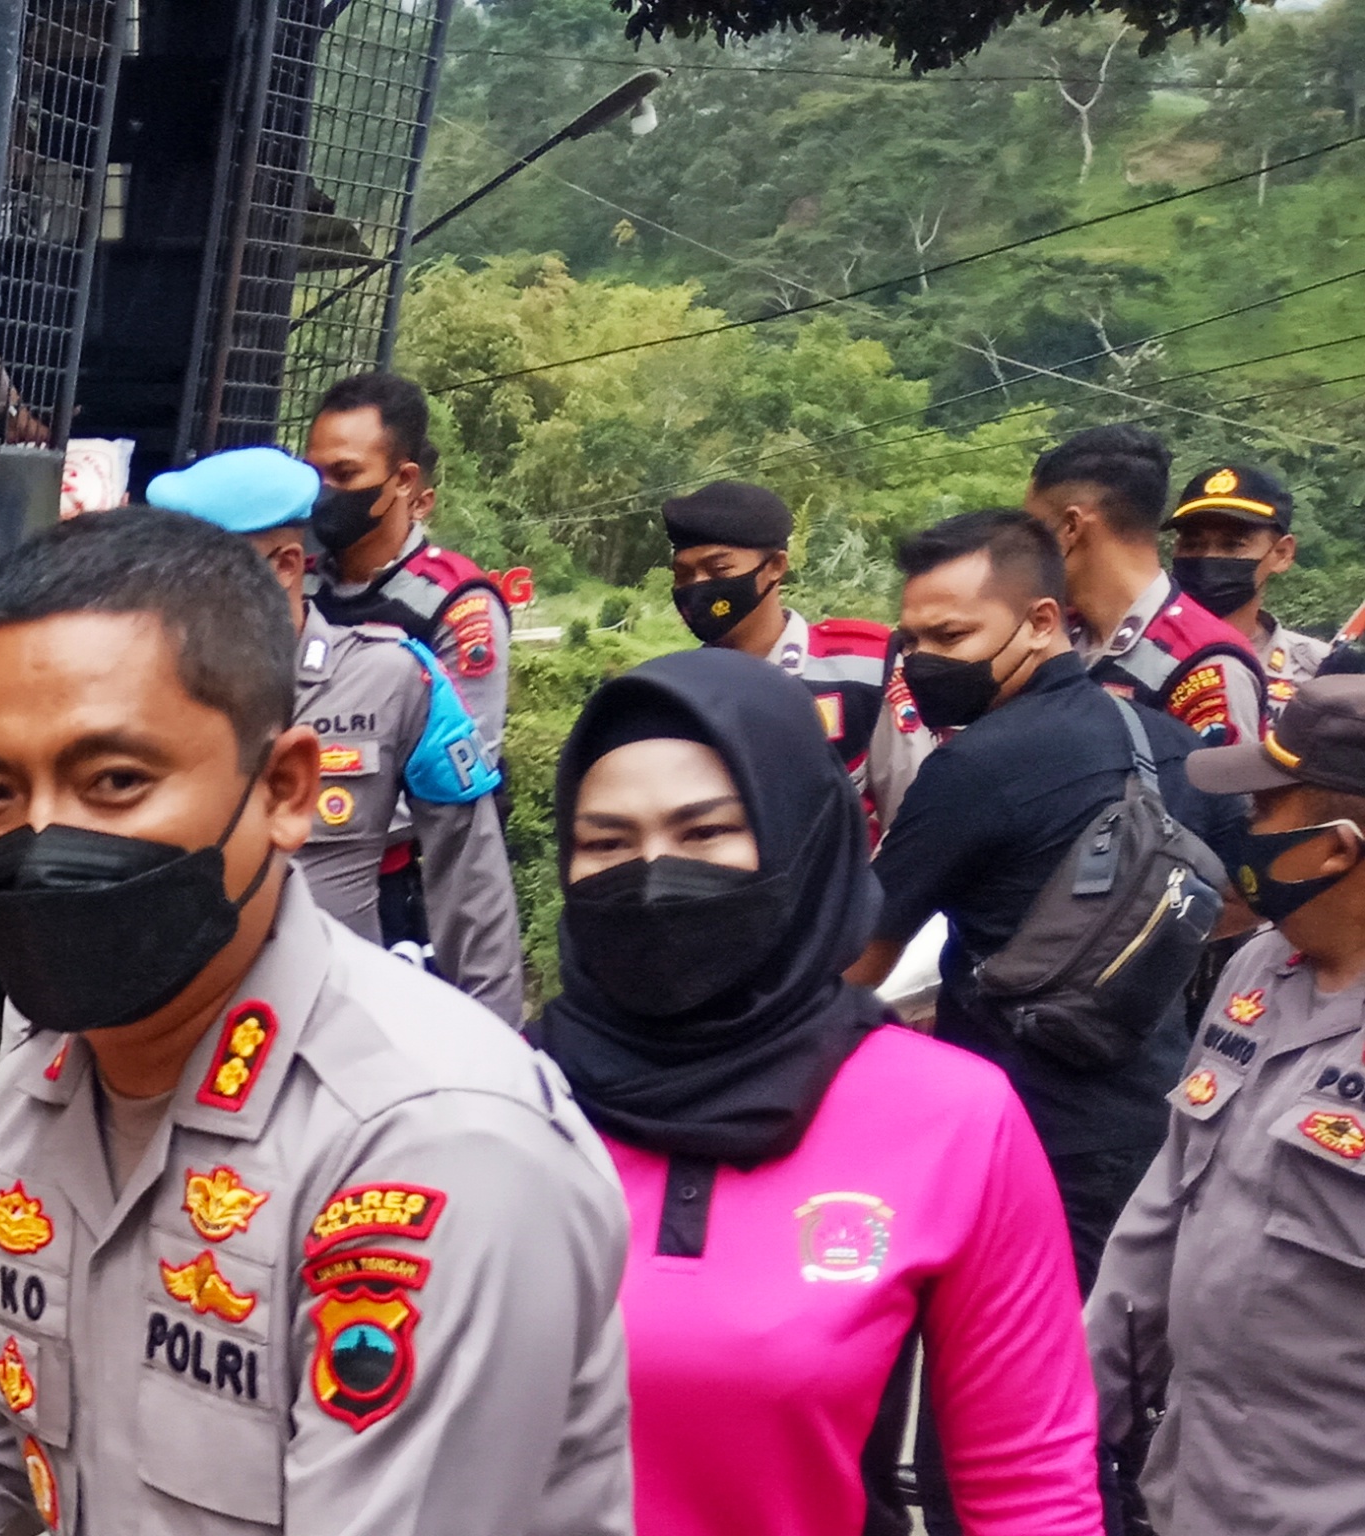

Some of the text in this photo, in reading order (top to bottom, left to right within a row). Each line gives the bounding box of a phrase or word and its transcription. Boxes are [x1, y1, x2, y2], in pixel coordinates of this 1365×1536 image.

[300, 713, 376, 735] OLRI
[314, 1190, 426, 1234] POLRES
[146, 1312, 257, 1400] POLRI
